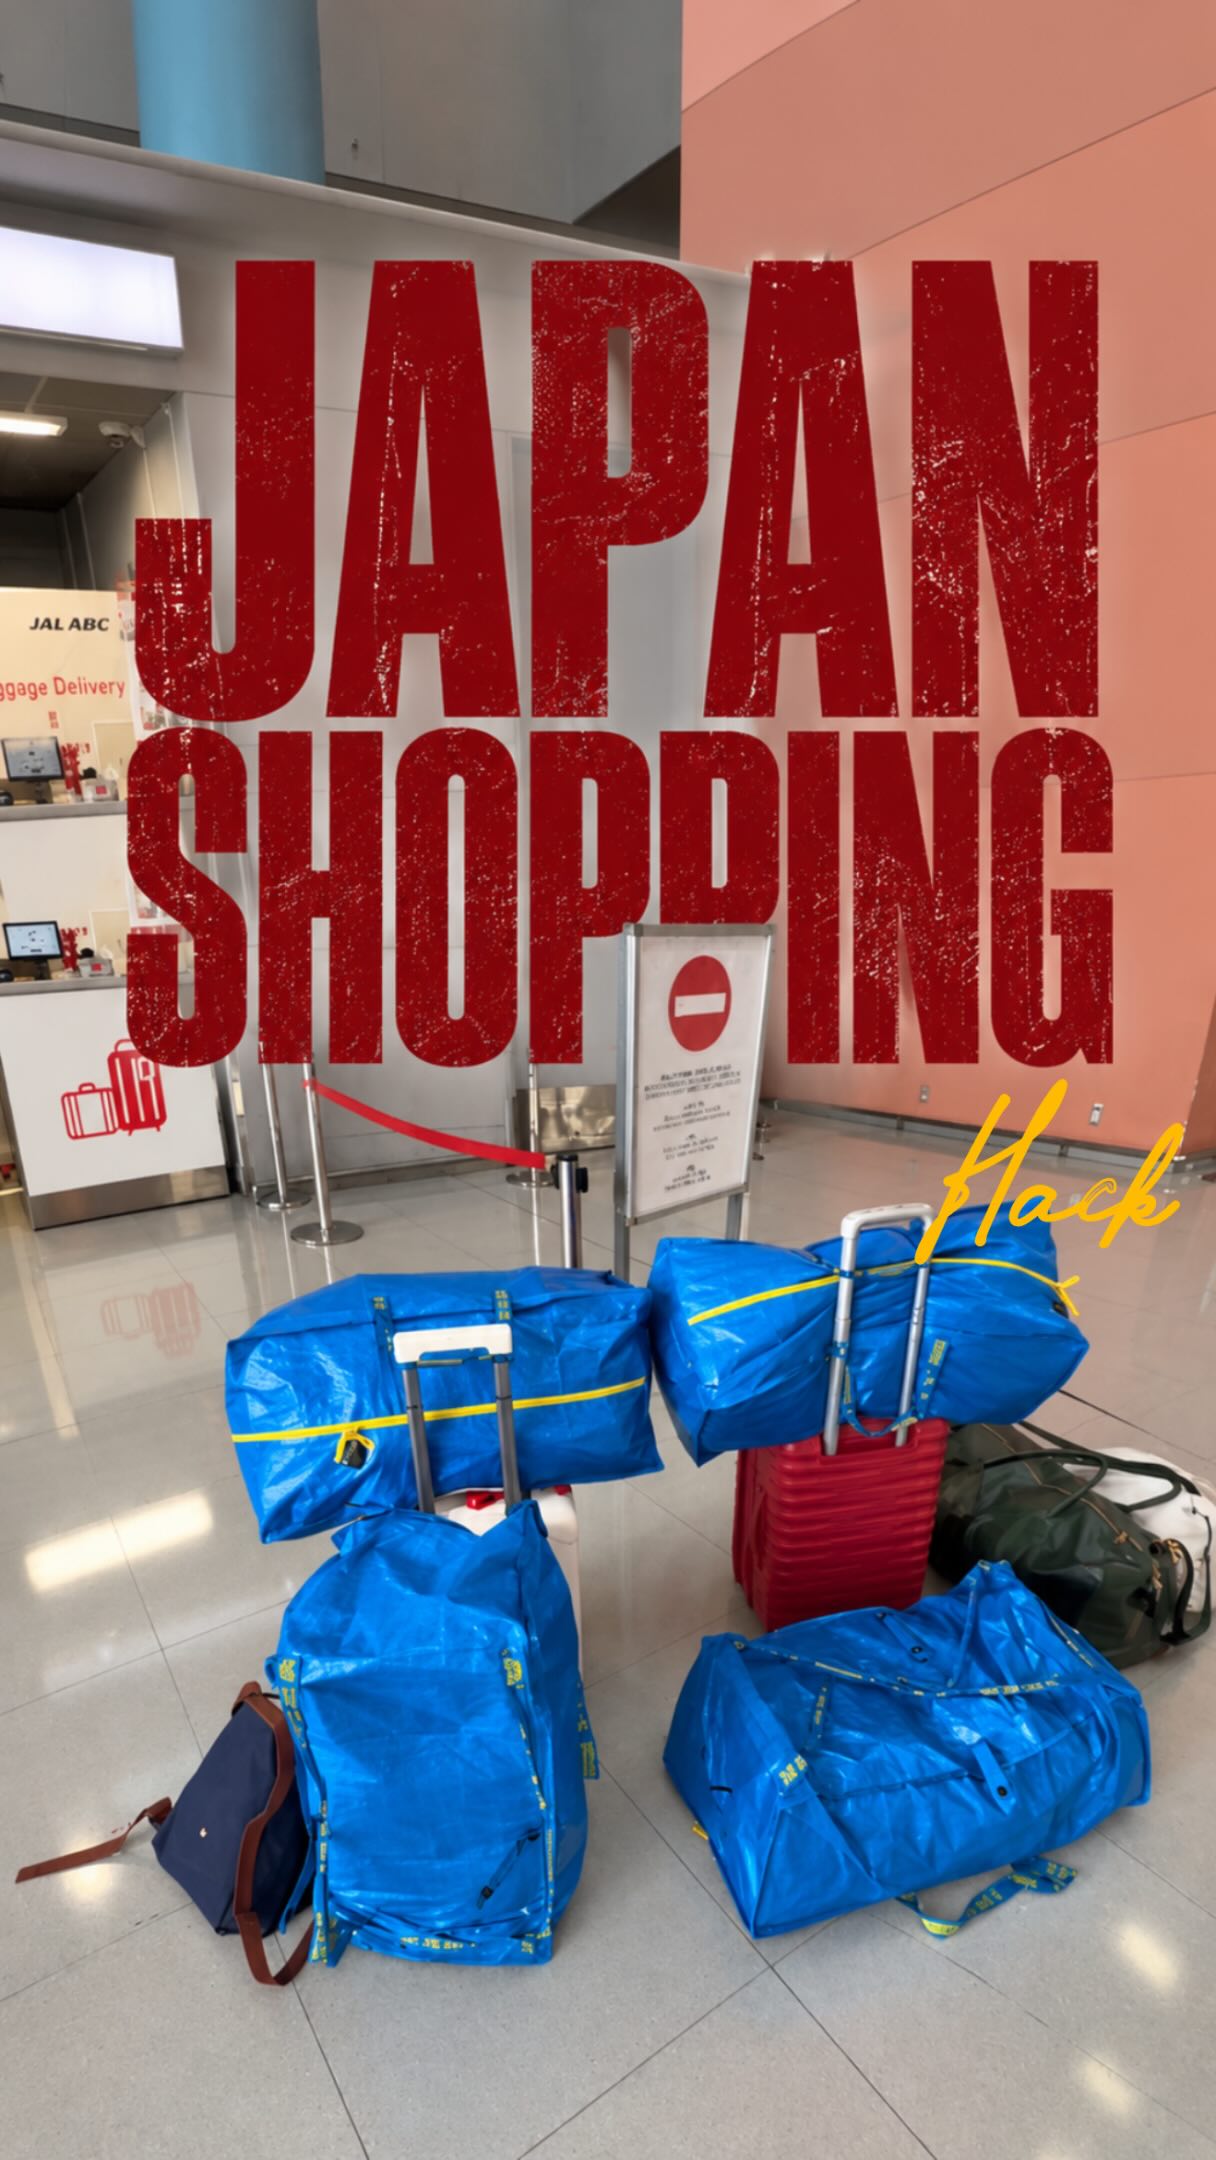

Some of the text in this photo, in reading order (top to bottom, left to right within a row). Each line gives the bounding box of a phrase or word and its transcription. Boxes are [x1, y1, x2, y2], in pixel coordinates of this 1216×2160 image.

[29, 617, 110, 631] JAL ABC
[53, 676, 125, 699] Delivery
